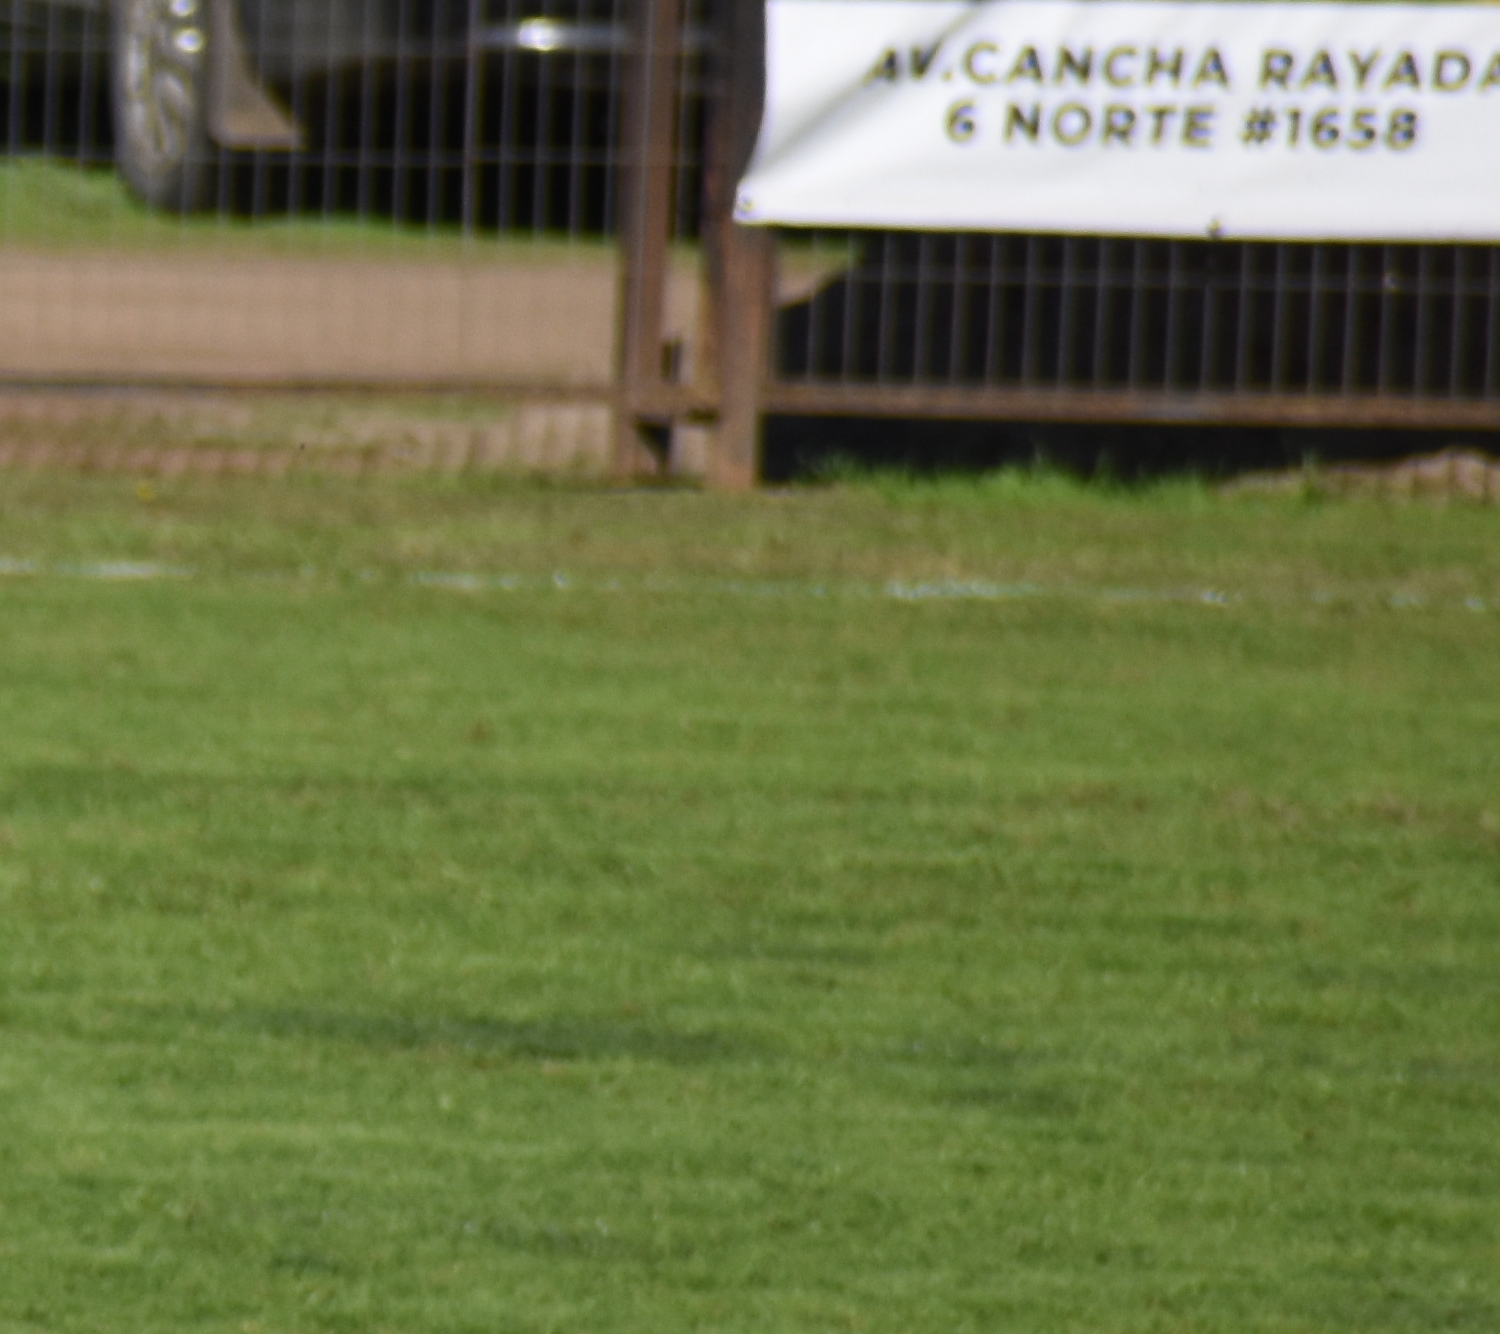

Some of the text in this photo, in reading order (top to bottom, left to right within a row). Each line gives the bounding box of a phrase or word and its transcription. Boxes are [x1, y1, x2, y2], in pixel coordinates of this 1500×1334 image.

[1258, 46, 1500, 94] RAYADA
[943, 97, 1418, 151] 6 NORTE #1658
